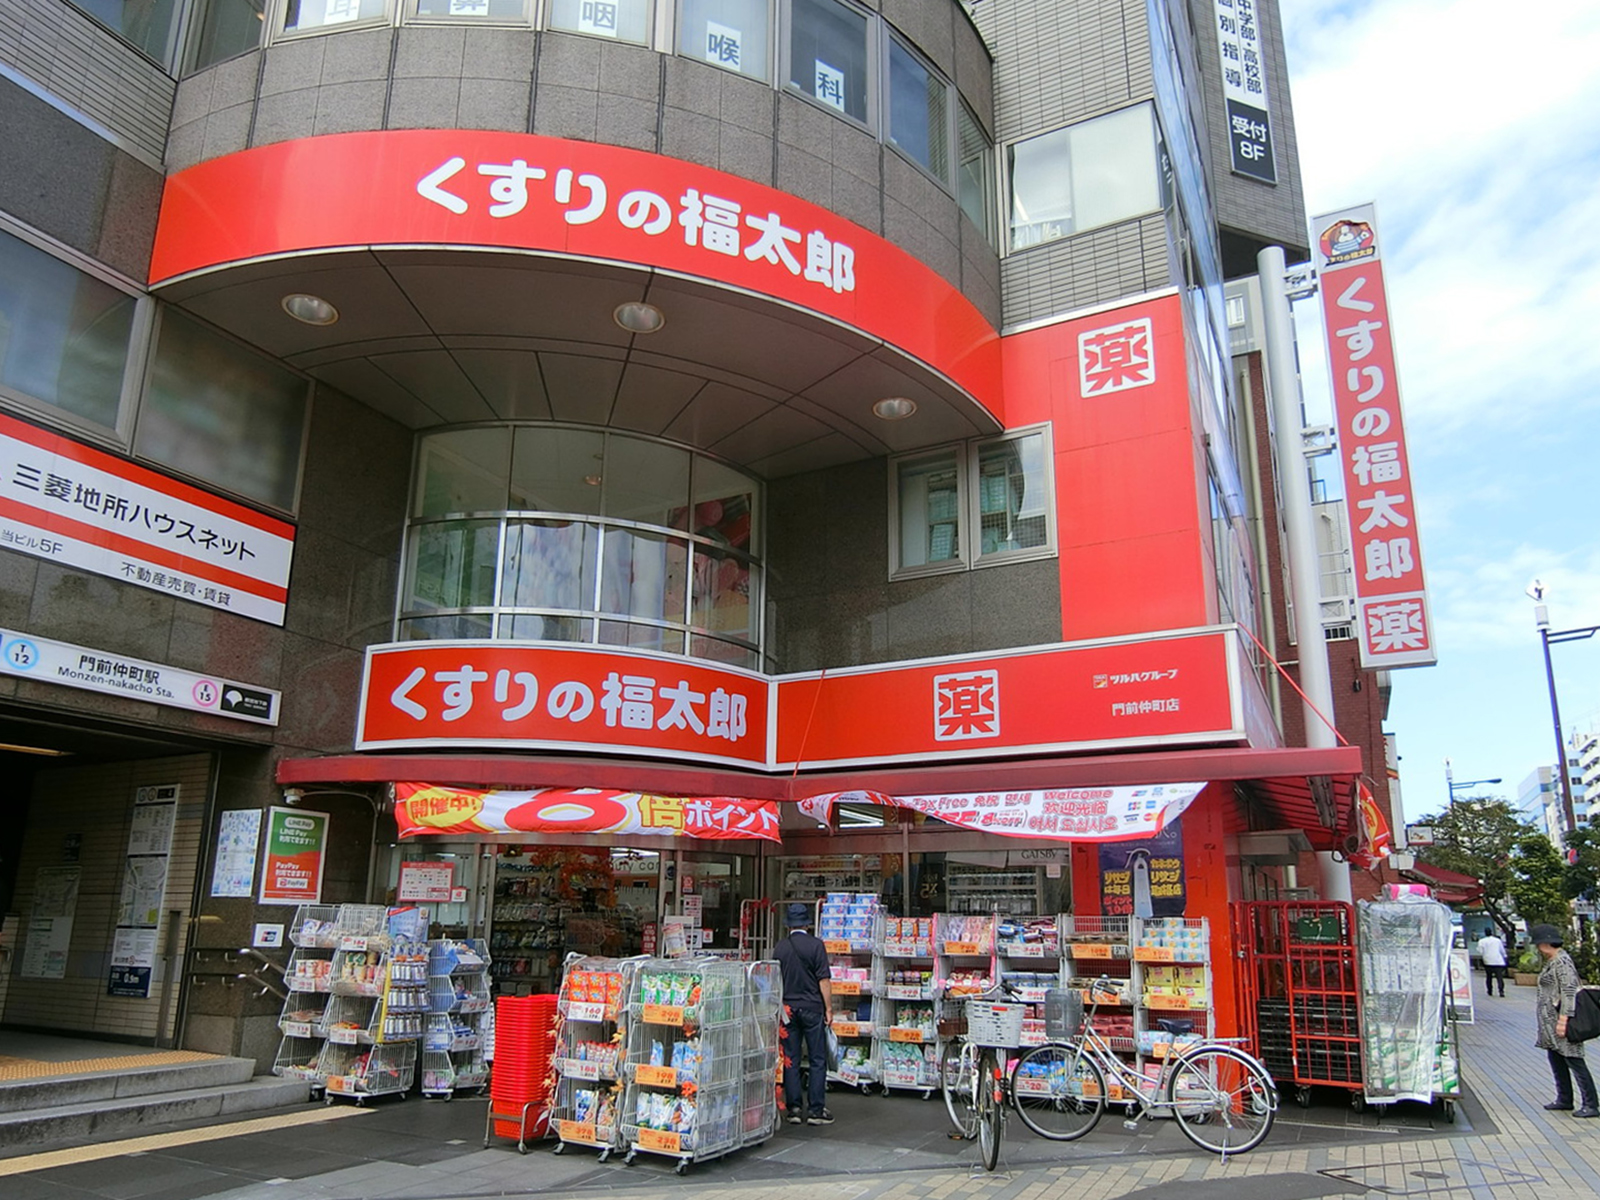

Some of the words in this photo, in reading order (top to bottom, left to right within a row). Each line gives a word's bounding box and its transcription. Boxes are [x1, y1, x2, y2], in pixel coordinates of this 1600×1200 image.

[708, 33, 740, 66] 喉
[818, 71, 843, 105] 科
[1231, 115, 1267, 142] 受付
[1240, 141, 1265, 161] 8F
[416, 156, 856, 293] くすりの福太郎
[1082, 325, 1149, 393] 薬
[1336, 276, 1414, 581] くすりの福太郎
[13, 463, 256, 561] 三菱地所ハウスネット
[121, 561, 232, 608] 不動産売買・賃貸
[1367, 602, 1425, 652] 薬
[14, 653, 30, 665] 12
[79, 654, 160, 685] 門前仲町駅
[58, 666, 154, 695] Monzen-nakacho
[155, 686, 175, 699] Sta.
[1109, 668, 1178, 685] ツルハグループ
[199, 691, 212, 702] 15
[391, 664, 747, 742] くすりの福太郎
[938, 675, 995, 736] 薬
[1111, 697, 1180, 717] 門前仲町店
[409, 795, 479, 818] 開催中!
[938, 796, 970, 810] Free
[1043, 789, 1114, 801] Welcome
[685, 800, 778, 830] ポイント
[1042, 801, 1109, 817] 欢迎光临
[1028, 815, 1059, 833] 어서
[1021, 850, 1058, 860] GATSBY
[585, 1007, 602, 1015] 160
[661, 1009, 681, 1018] 298
[655, 1071, 674, 1080] 198
